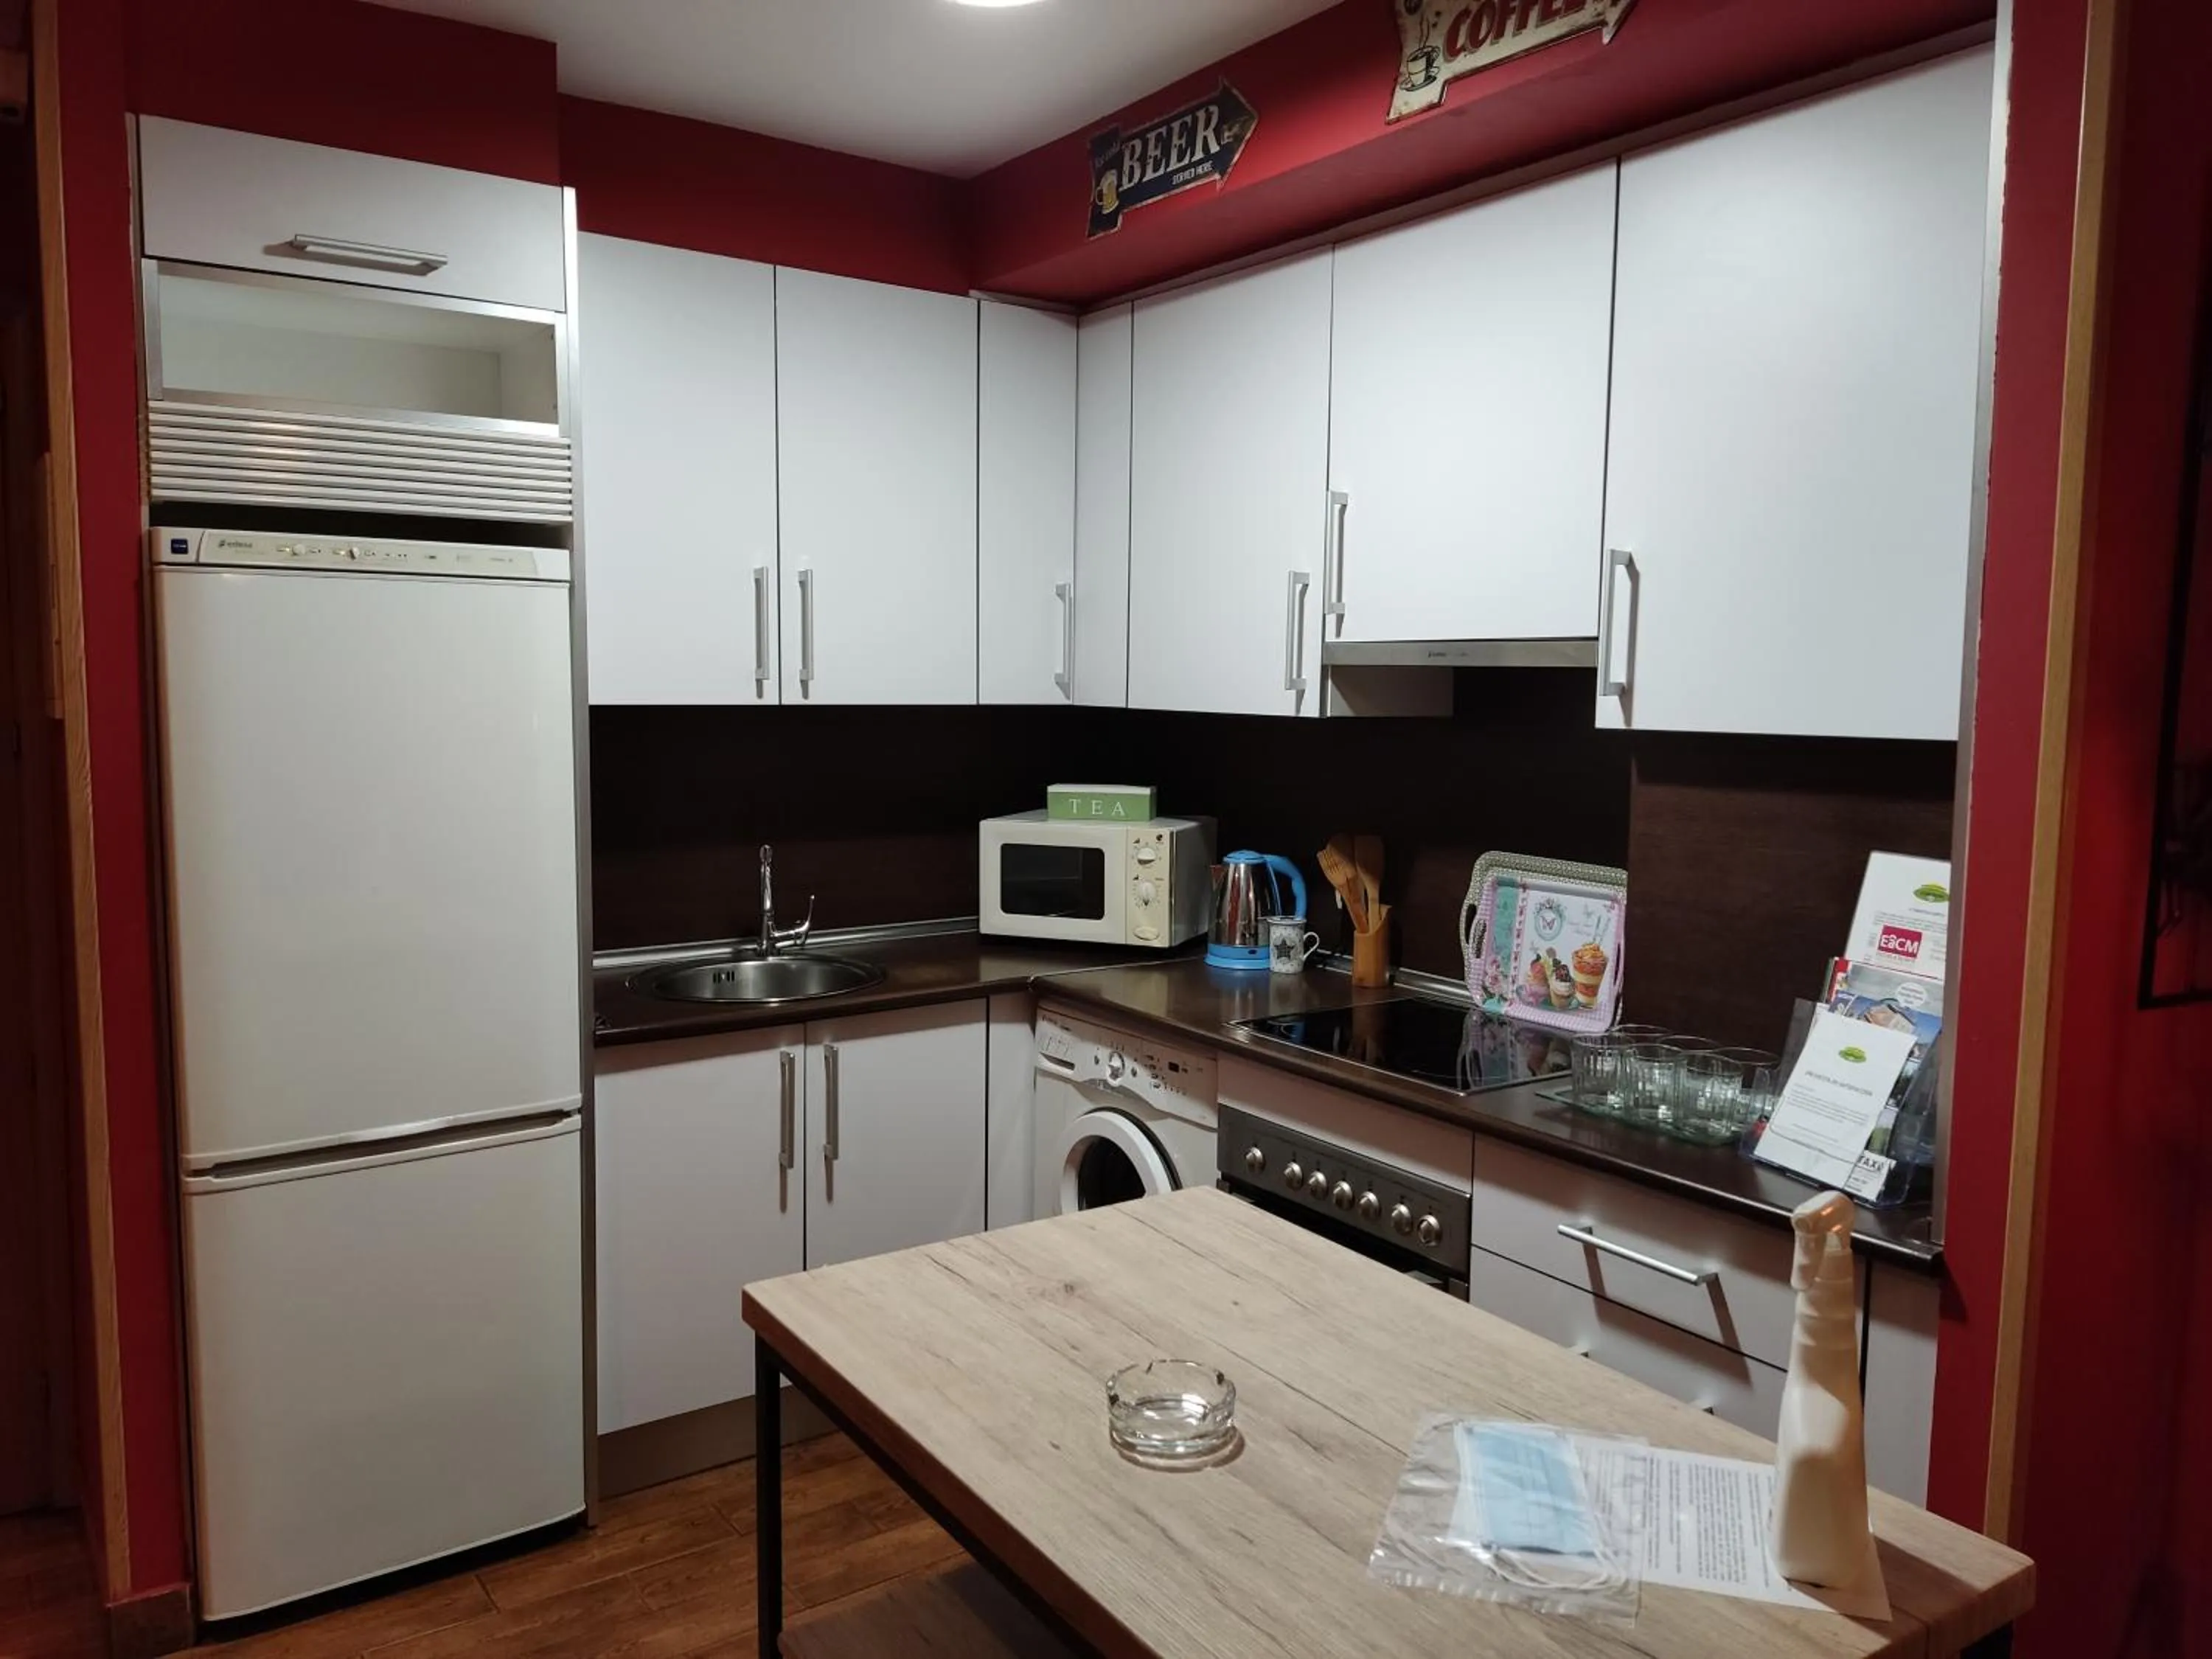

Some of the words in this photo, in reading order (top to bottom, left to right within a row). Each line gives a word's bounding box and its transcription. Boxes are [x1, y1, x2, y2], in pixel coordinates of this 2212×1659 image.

[1443, 0, 1585, 62] COFF
[1119, 105, 1220, 192] BEER
[1068, 799, 1126, 817] TEA
